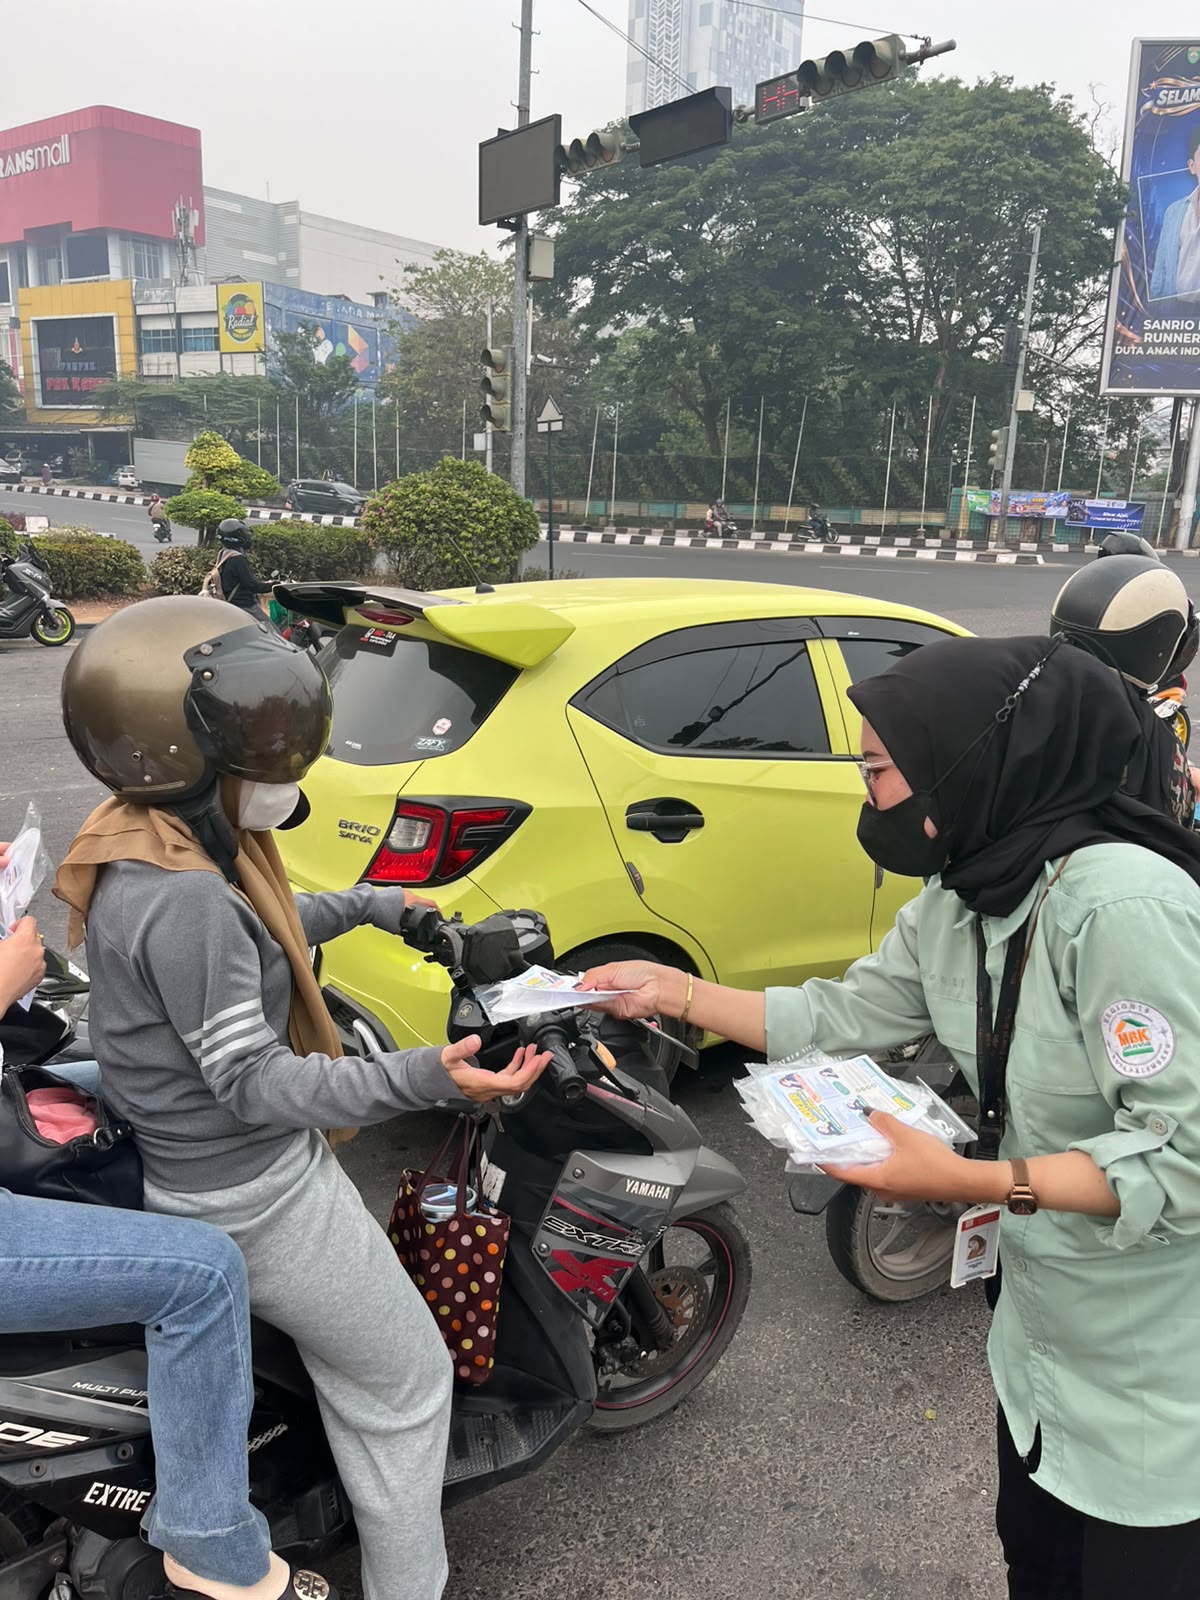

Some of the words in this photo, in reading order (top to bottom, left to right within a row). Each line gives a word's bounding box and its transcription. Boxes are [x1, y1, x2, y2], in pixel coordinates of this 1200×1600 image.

[1156, 88, 1200, 105] SELAM
[227, 314, 255, 329] Radial
[1143, 319, 1195, 330] SANRIO
[1143, 332, 1200, 344] RUNNER
[1115, 345, 1144, 355] DUTA
[1146, 346, 1178, 355] ANAK
[338, 818, 381, 836] BRIO
[338, 830, 373, 844] SATYA
[1117, 1027, 1151, 1047] MBK
[625, 1179, 671, 1200] YAMAHA
[71, 1381, 119, 1394] MULTI
[83, 1481, 152, 1512] EXTRE
